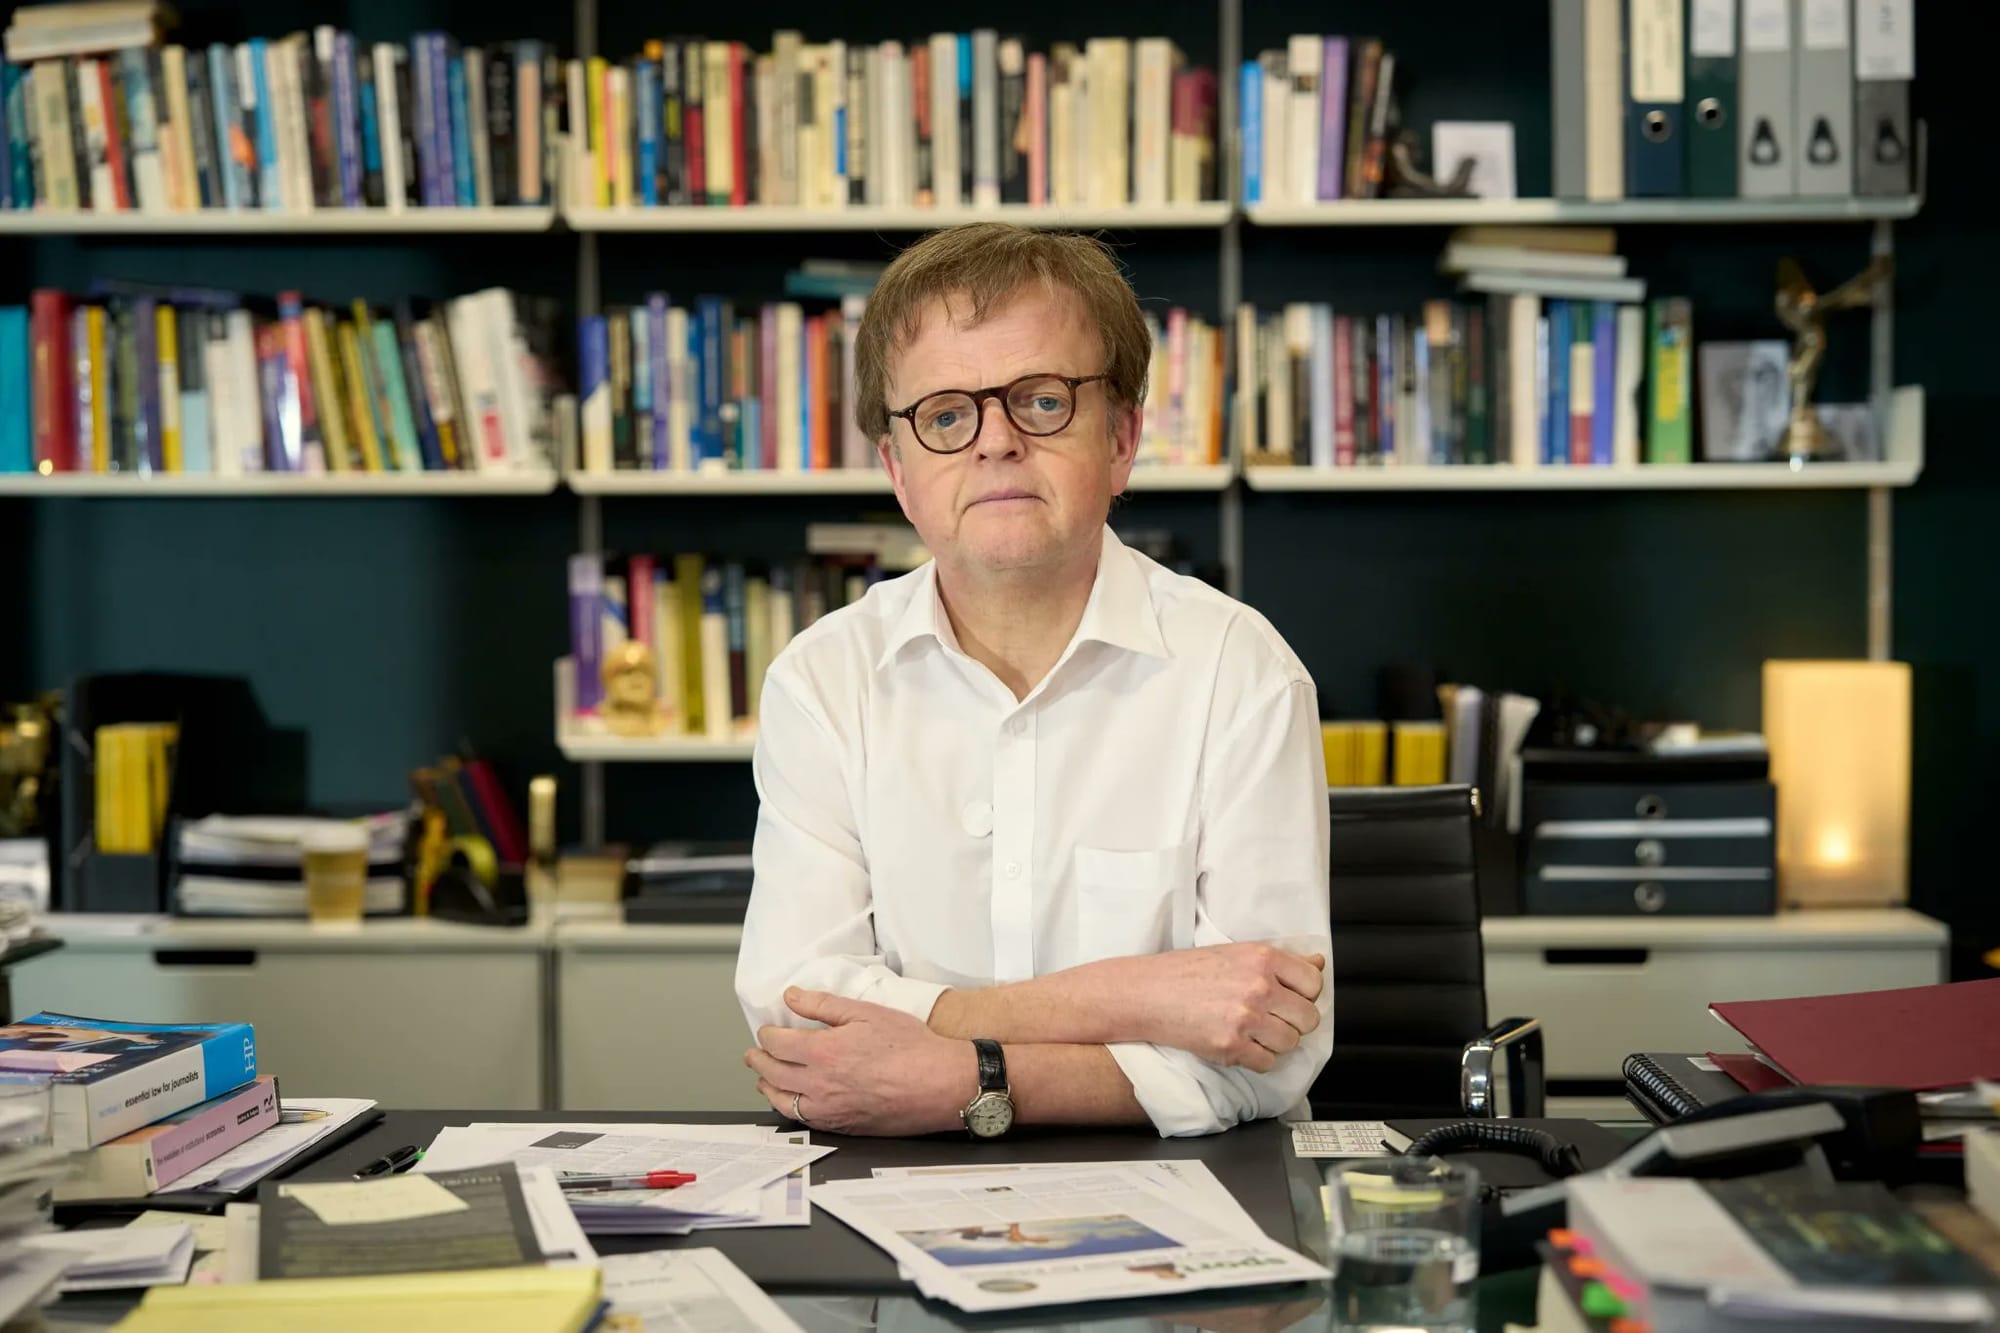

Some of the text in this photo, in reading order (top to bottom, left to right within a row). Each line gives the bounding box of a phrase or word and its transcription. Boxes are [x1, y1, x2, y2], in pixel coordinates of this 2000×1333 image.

[125, 1071, 199, 1108] essential law for journalists
[206, 1125, 225, 1141] economics
